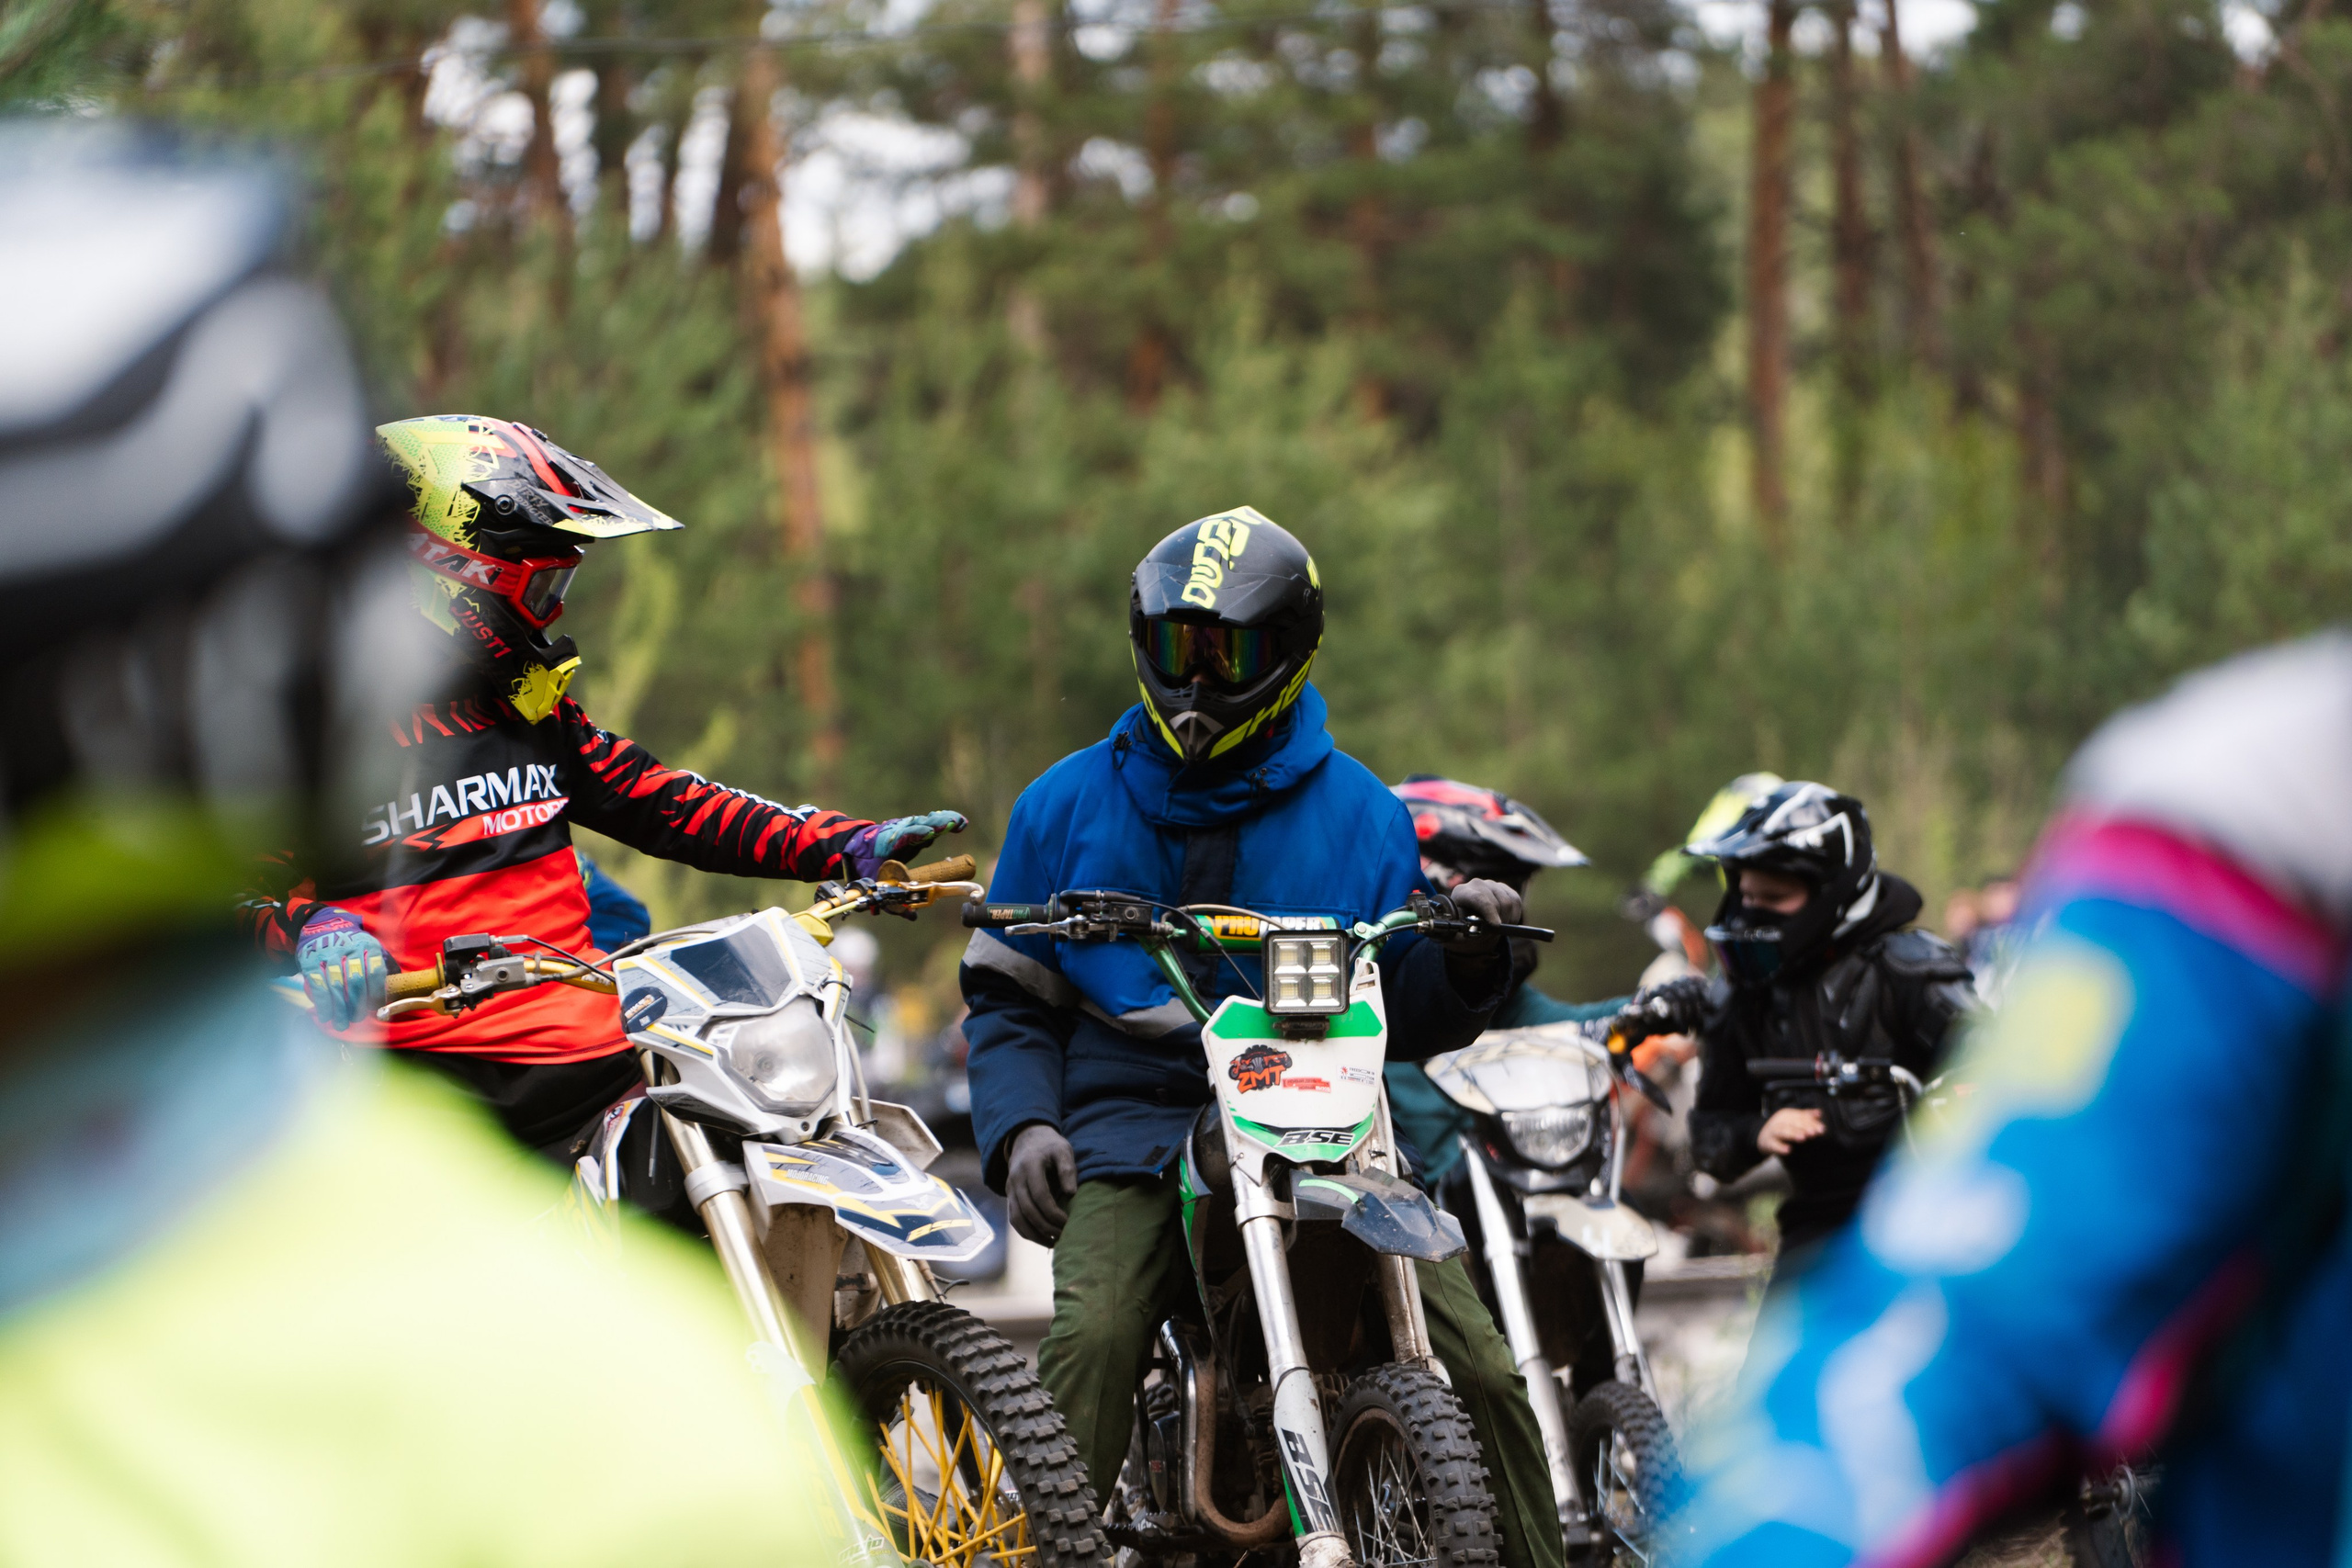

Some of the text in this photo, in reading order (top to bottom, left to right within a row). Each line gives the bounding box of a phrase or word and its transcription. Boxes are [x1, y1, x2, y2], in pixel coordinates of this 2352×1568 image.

[451, 606, 512, 658] JUST1
[361, 763, 561, 846] SHARMAX
[302, 931, 355, 960] FOX
[1238, 1065, 1286, 1094] ZMT
[1278, 1130, 1354, 1147] BSE
[1281, 1427, 1338, 1532] BSE
